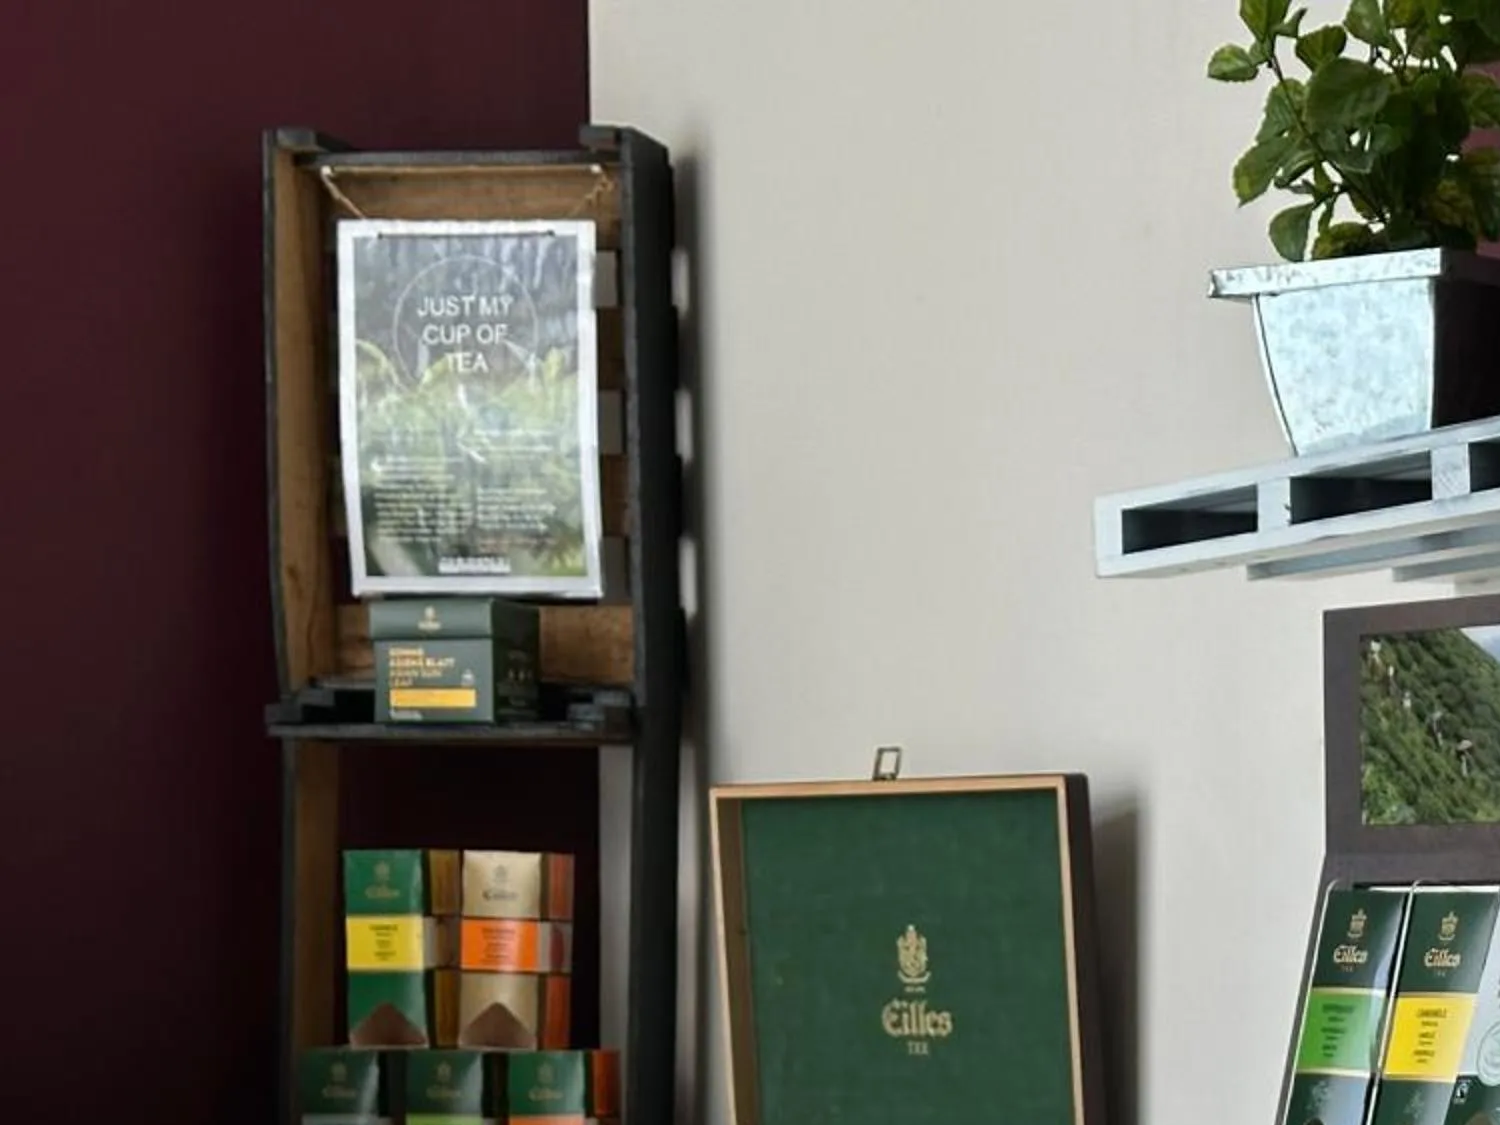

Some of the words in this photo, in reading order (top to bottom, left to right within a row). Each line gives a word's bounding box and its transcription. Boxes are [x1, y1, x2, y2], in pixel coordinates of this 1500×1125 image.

[416, 294, 475, 318] JUST
[478, 294, 514, 317] MY
[422, 323, 471, 345] CUP
[476, 323, 508, 345] OF
[446, 351, 489, 374] TEA
[882, 998, 953, 1037] Eilles
